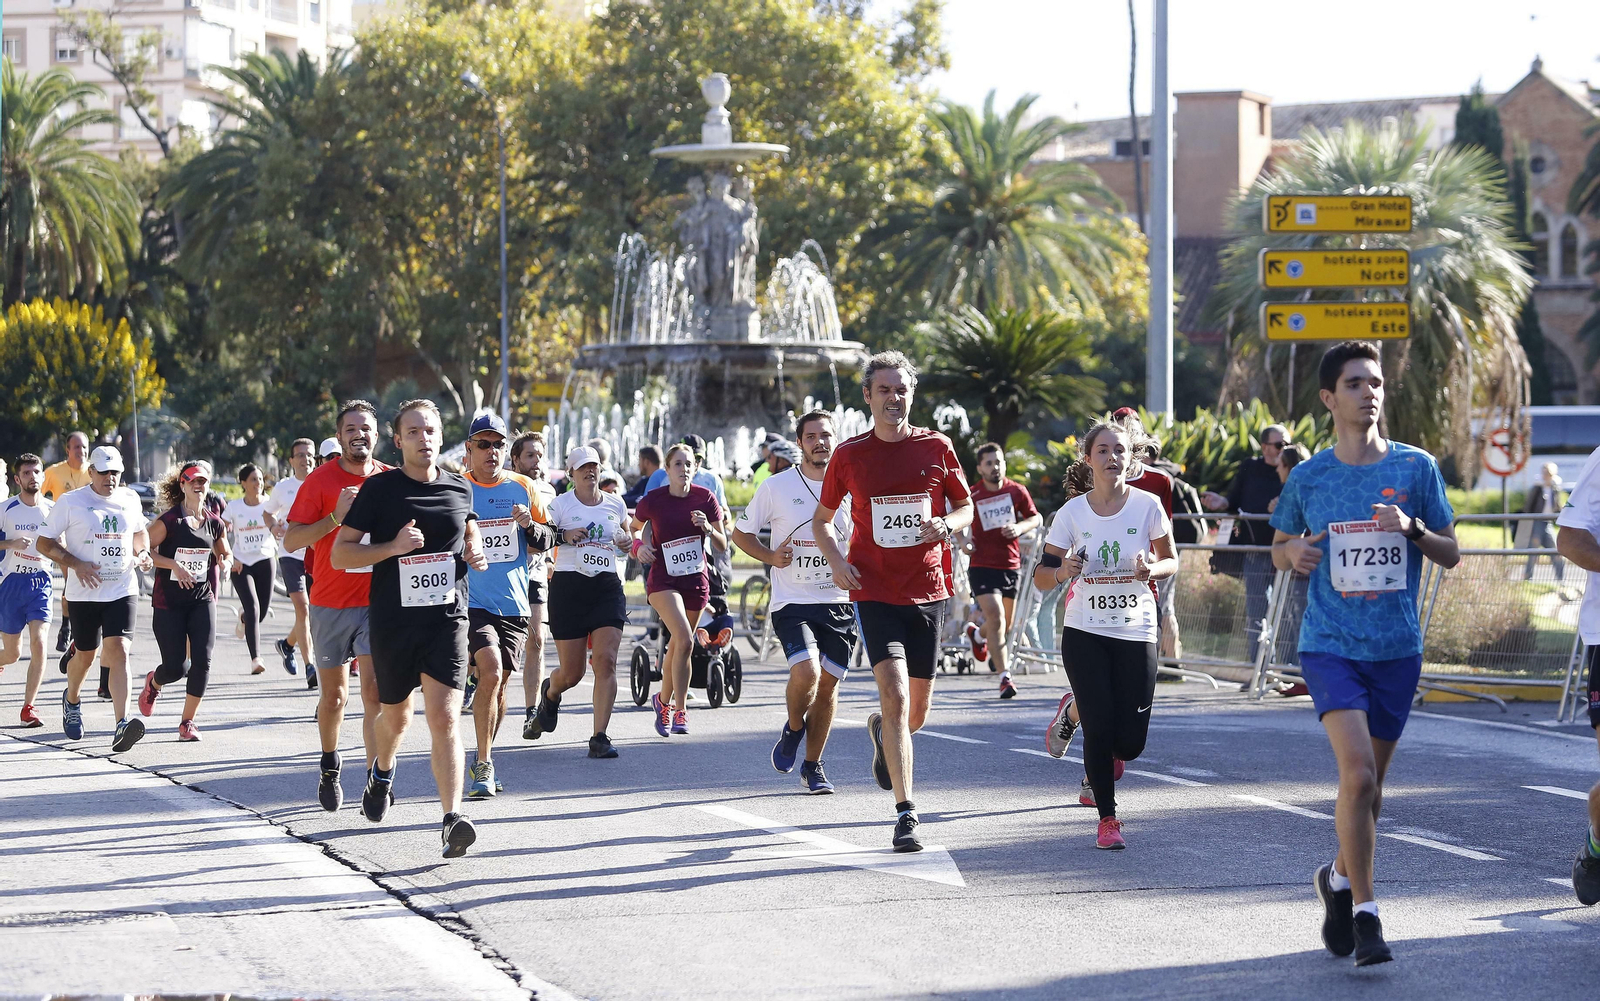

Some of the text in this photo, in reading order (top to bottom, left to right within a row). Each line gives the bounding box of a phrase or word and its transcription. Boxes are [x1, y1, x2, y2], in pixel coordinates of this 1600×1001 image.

[1350, 201, 1407, 211] Gran Hotel
[1355, 216, 1407, 227] Miramar
[1323, 254, 1405, 264] hoteles zona
[1361, 269, 1405, 280] Norte
[1324, 306, 1406, 317] hoteles zona
[1370, 320, 1407, 333] Este
[983, 505, 1011, 519] 17950
[882, 514, 922, 530] 2463
[1331, 524, 1345, 534] 41
[244, 534, 264, 543] 3037
[101, 546, 127, 557] 3623
[671, 550, 698, 564] 9053
[1338, 546, 1402, 567] 17238
[400, 557, 411, 565] 41
[583, 553, 610, 567] 9560
[796, 555, 829, 568] 1766
[410, 572, 448, 589] 3608
[1088, 594, 1138, 610] 18333
